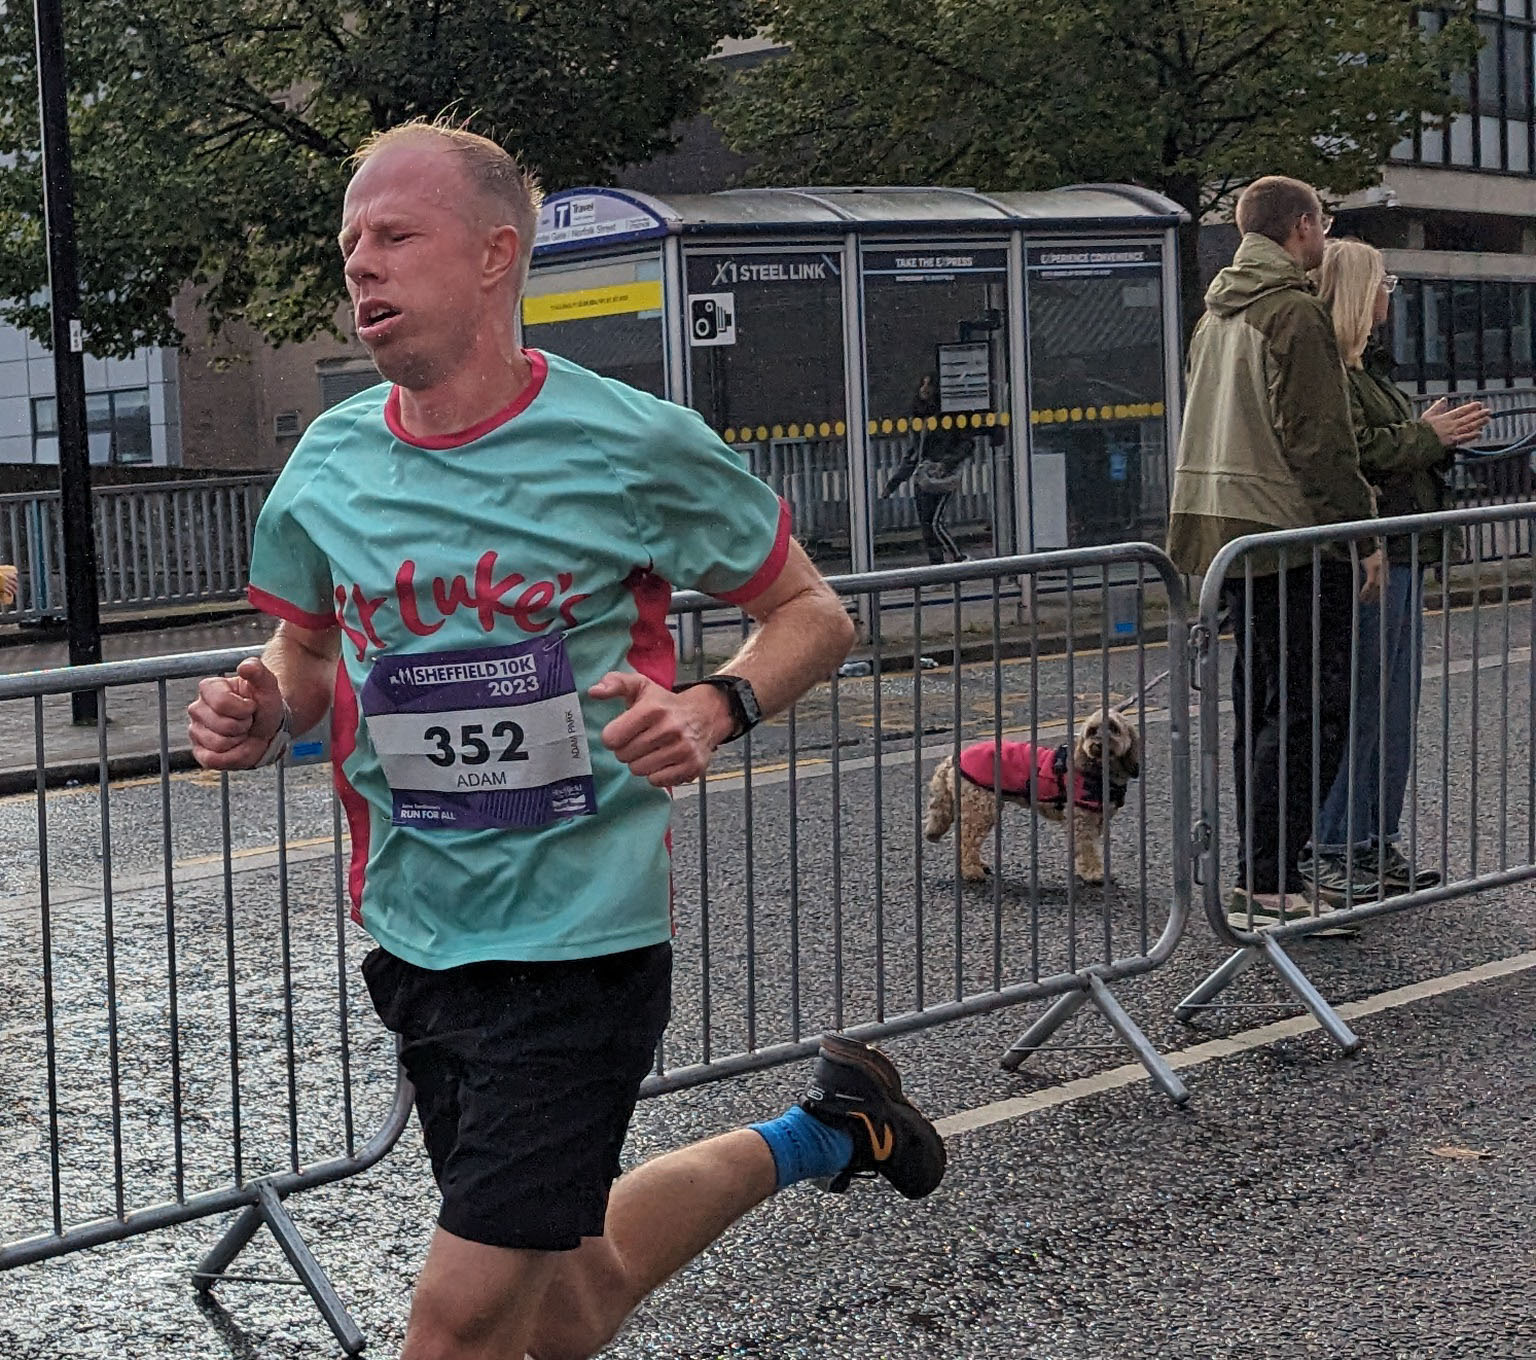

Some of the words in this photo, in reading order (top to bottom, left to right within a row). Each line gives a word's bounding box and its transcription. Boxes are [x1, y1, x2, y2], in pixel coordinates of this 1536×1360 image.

[712, 260, 738, 285] X1
[415, 663, 499, 683] SHEFFIELD
[499, 657, 534, 676] 10K
[488, 676, 539, 697] 2023
[424, 721, 529, 767] 352
[457, 771, 507, 788] ADAM
[400, 810, 421, 819] RUN
[422, 810, 440, 820] FOR
[441, 811, 457, 821] ALL
